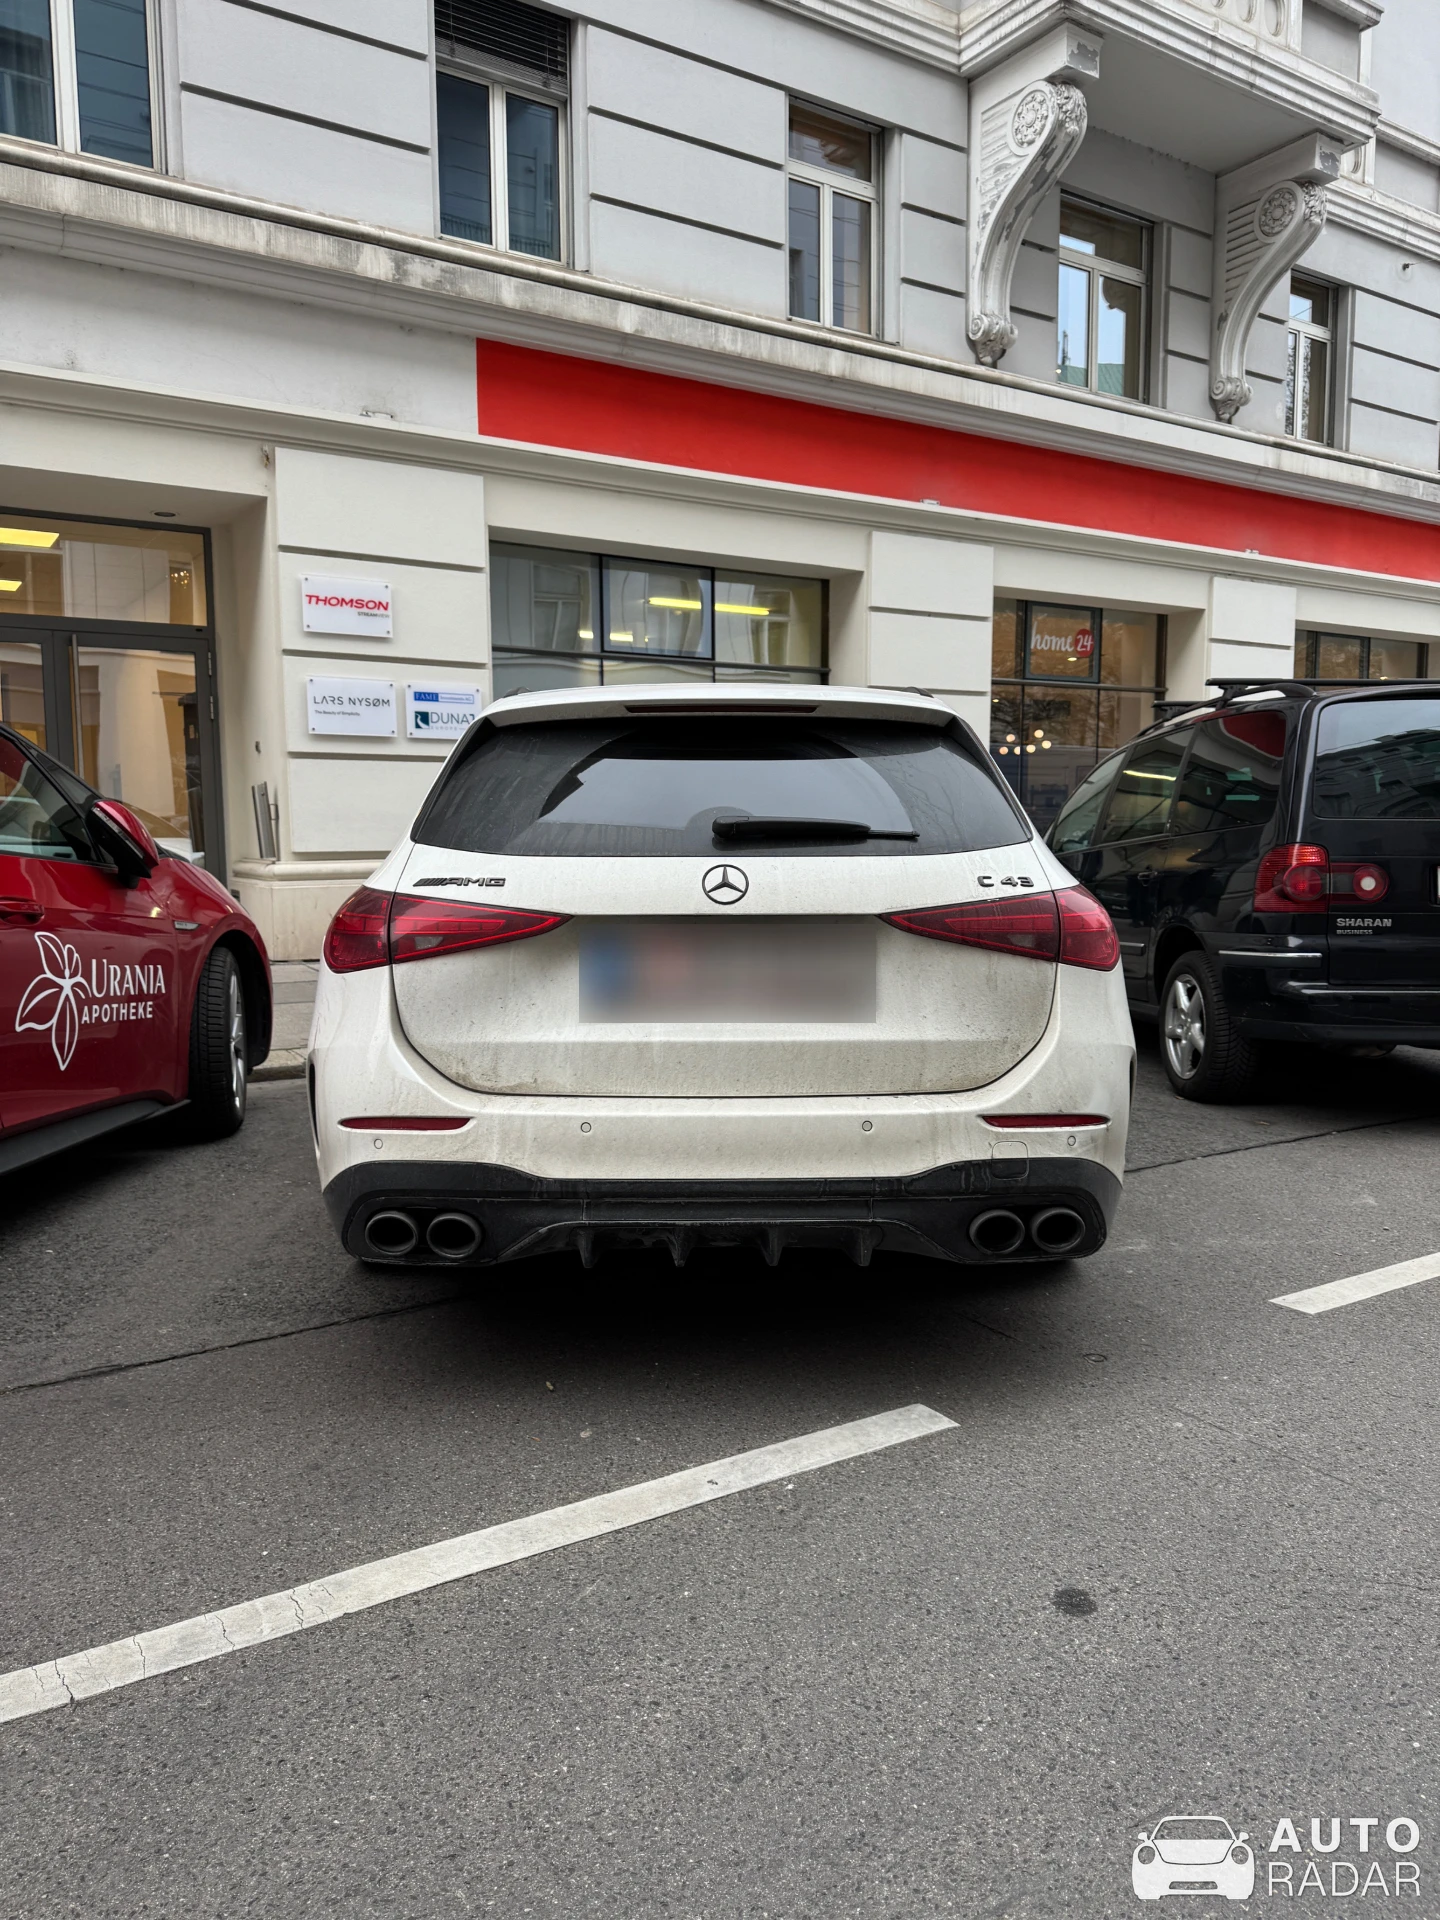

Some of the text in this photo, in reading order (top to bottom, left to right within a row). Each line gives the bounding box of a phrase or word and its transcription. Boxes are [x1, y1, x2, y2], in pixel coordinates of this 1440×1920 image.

[305, 594, 389, 611] THOMSON
[313, 695, 391, 707] LARS NYSØM
[415, 692, 438, 701] FAME
[441, 877, 506, 887] AMG
[977, 876, 1034, 887] C 43
[1336, 918, 1392, 927] SHARAN
[92, 959, 166, 997] URANIA
[81, 1001, 153, 1024] APOTHEKE
